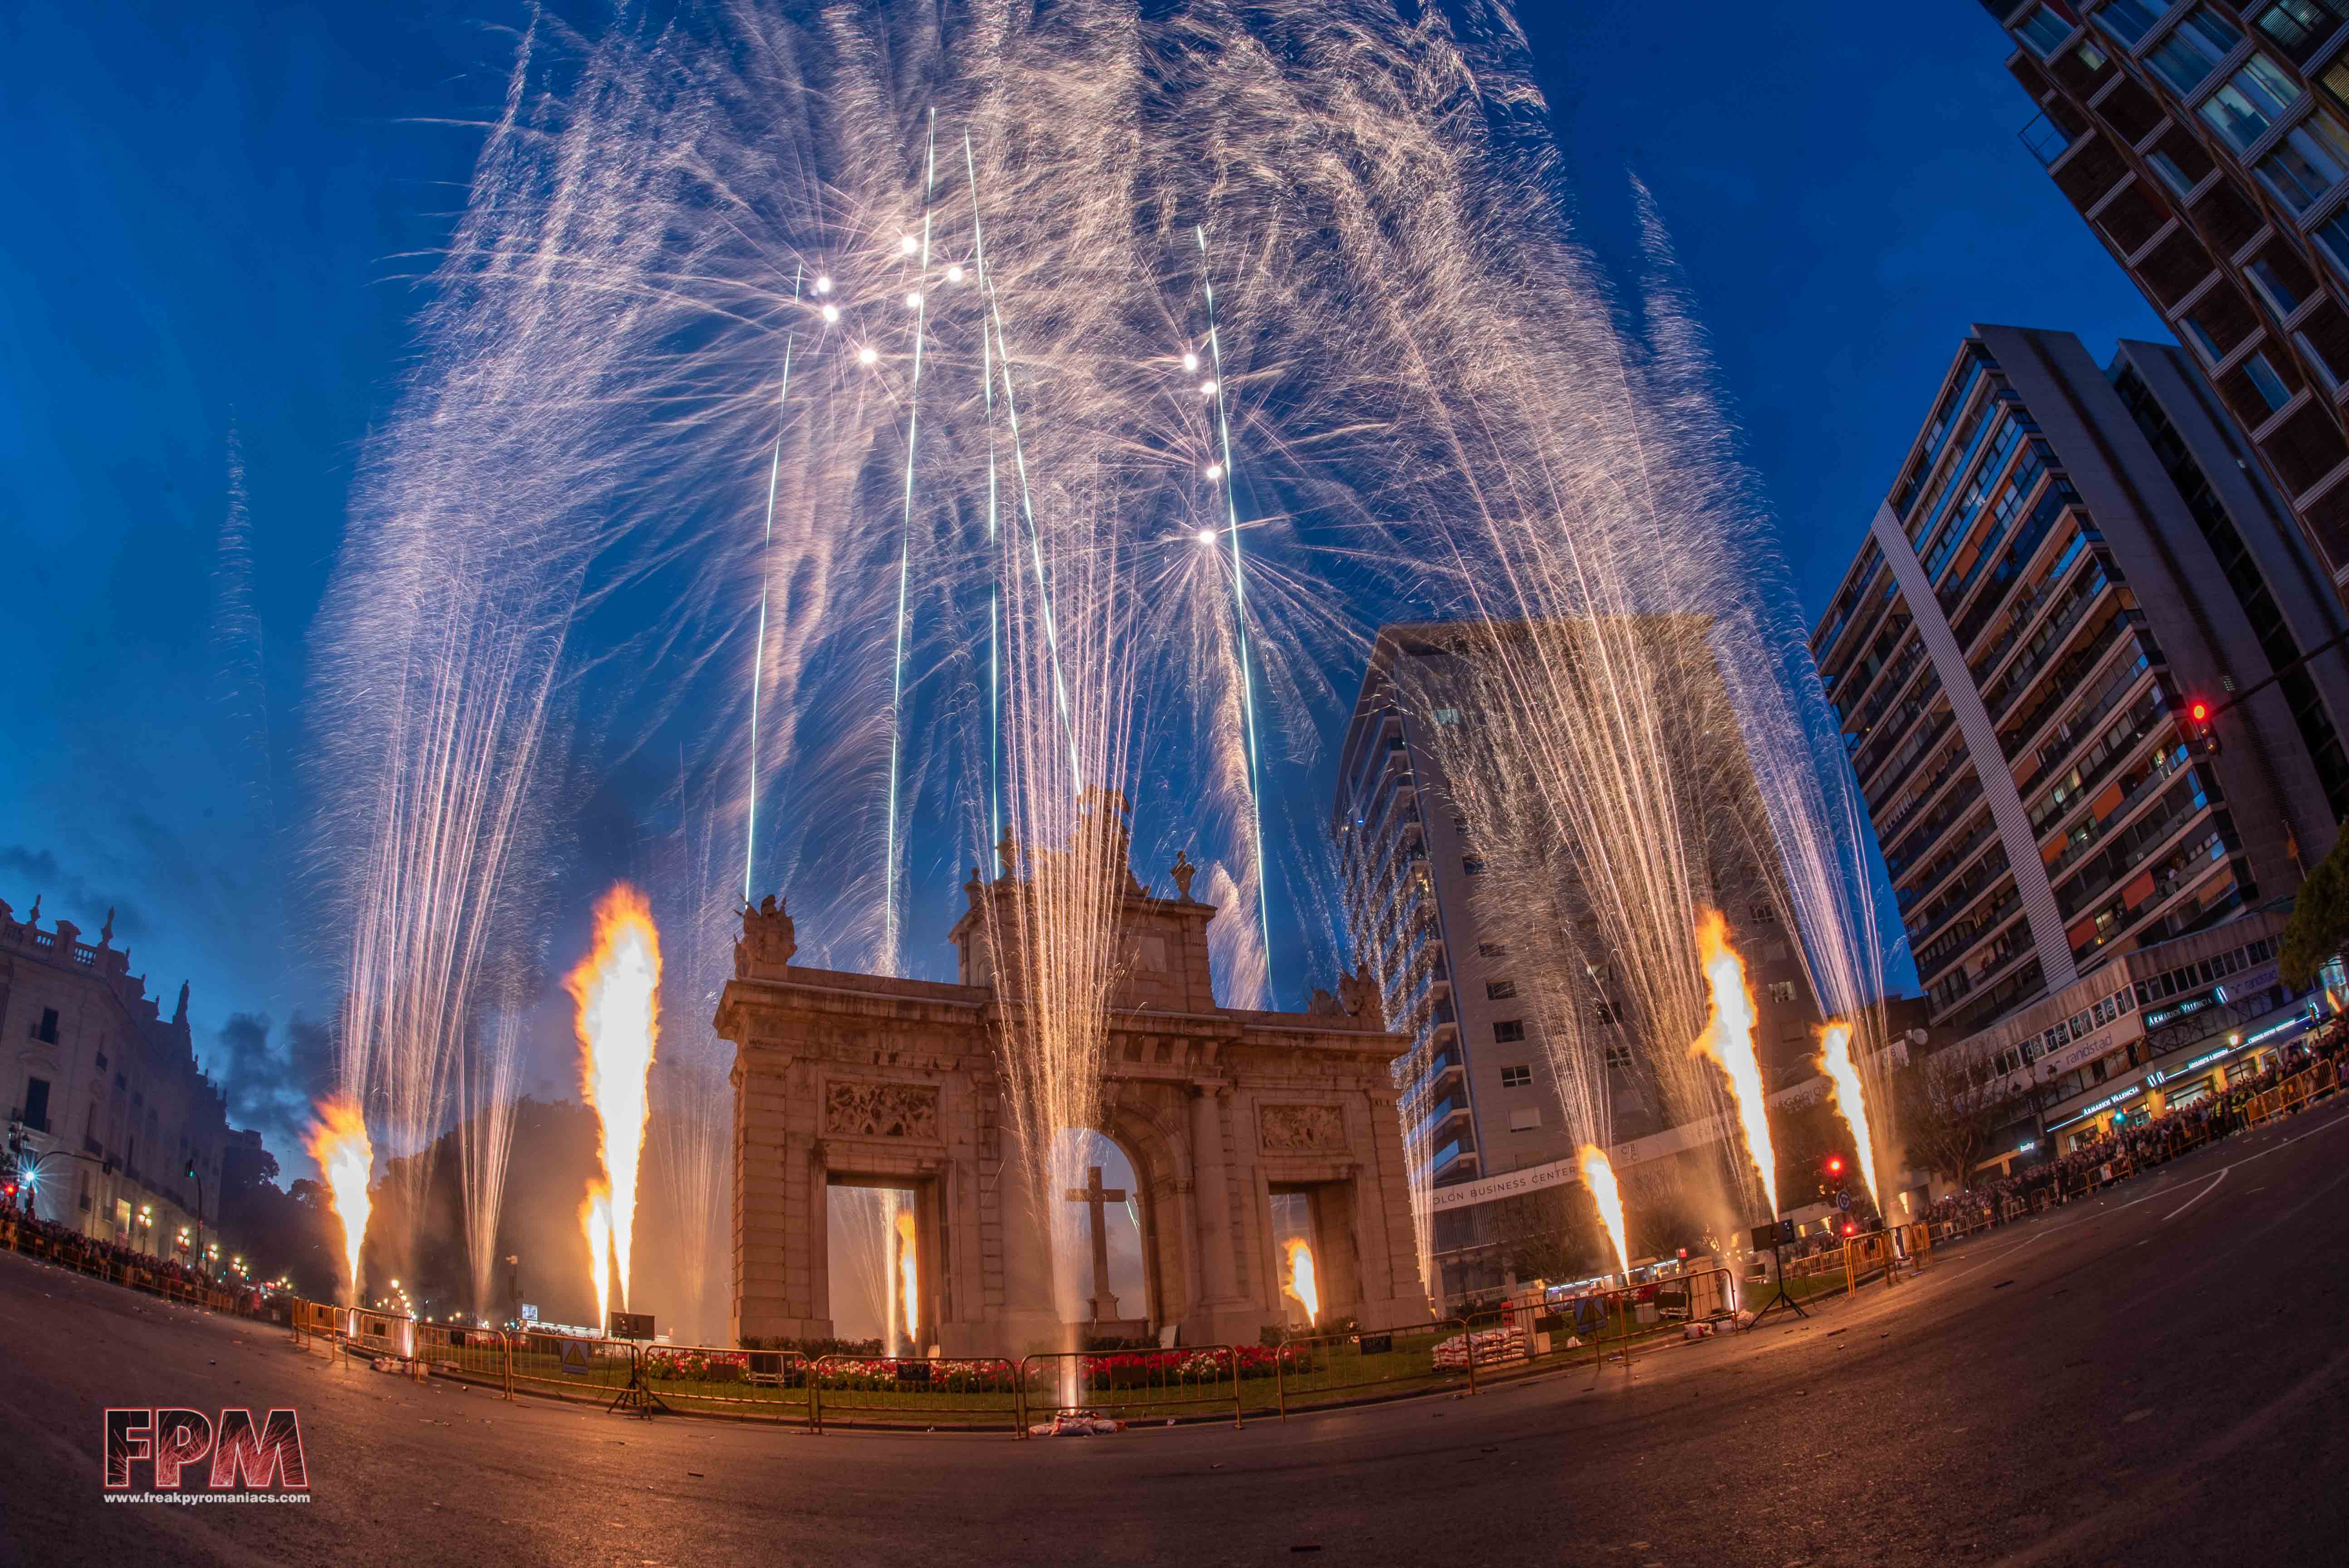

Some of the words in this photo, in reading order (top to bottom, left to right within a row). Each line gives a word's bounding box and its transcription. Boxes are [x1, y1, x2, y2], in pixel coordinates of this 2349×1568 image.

[2066, 1031, 2113, 1065] randstad
[1470, 1178, 1526, 1198] BUSINESS
[1532, 1166, 1576, 1184] CENTER
